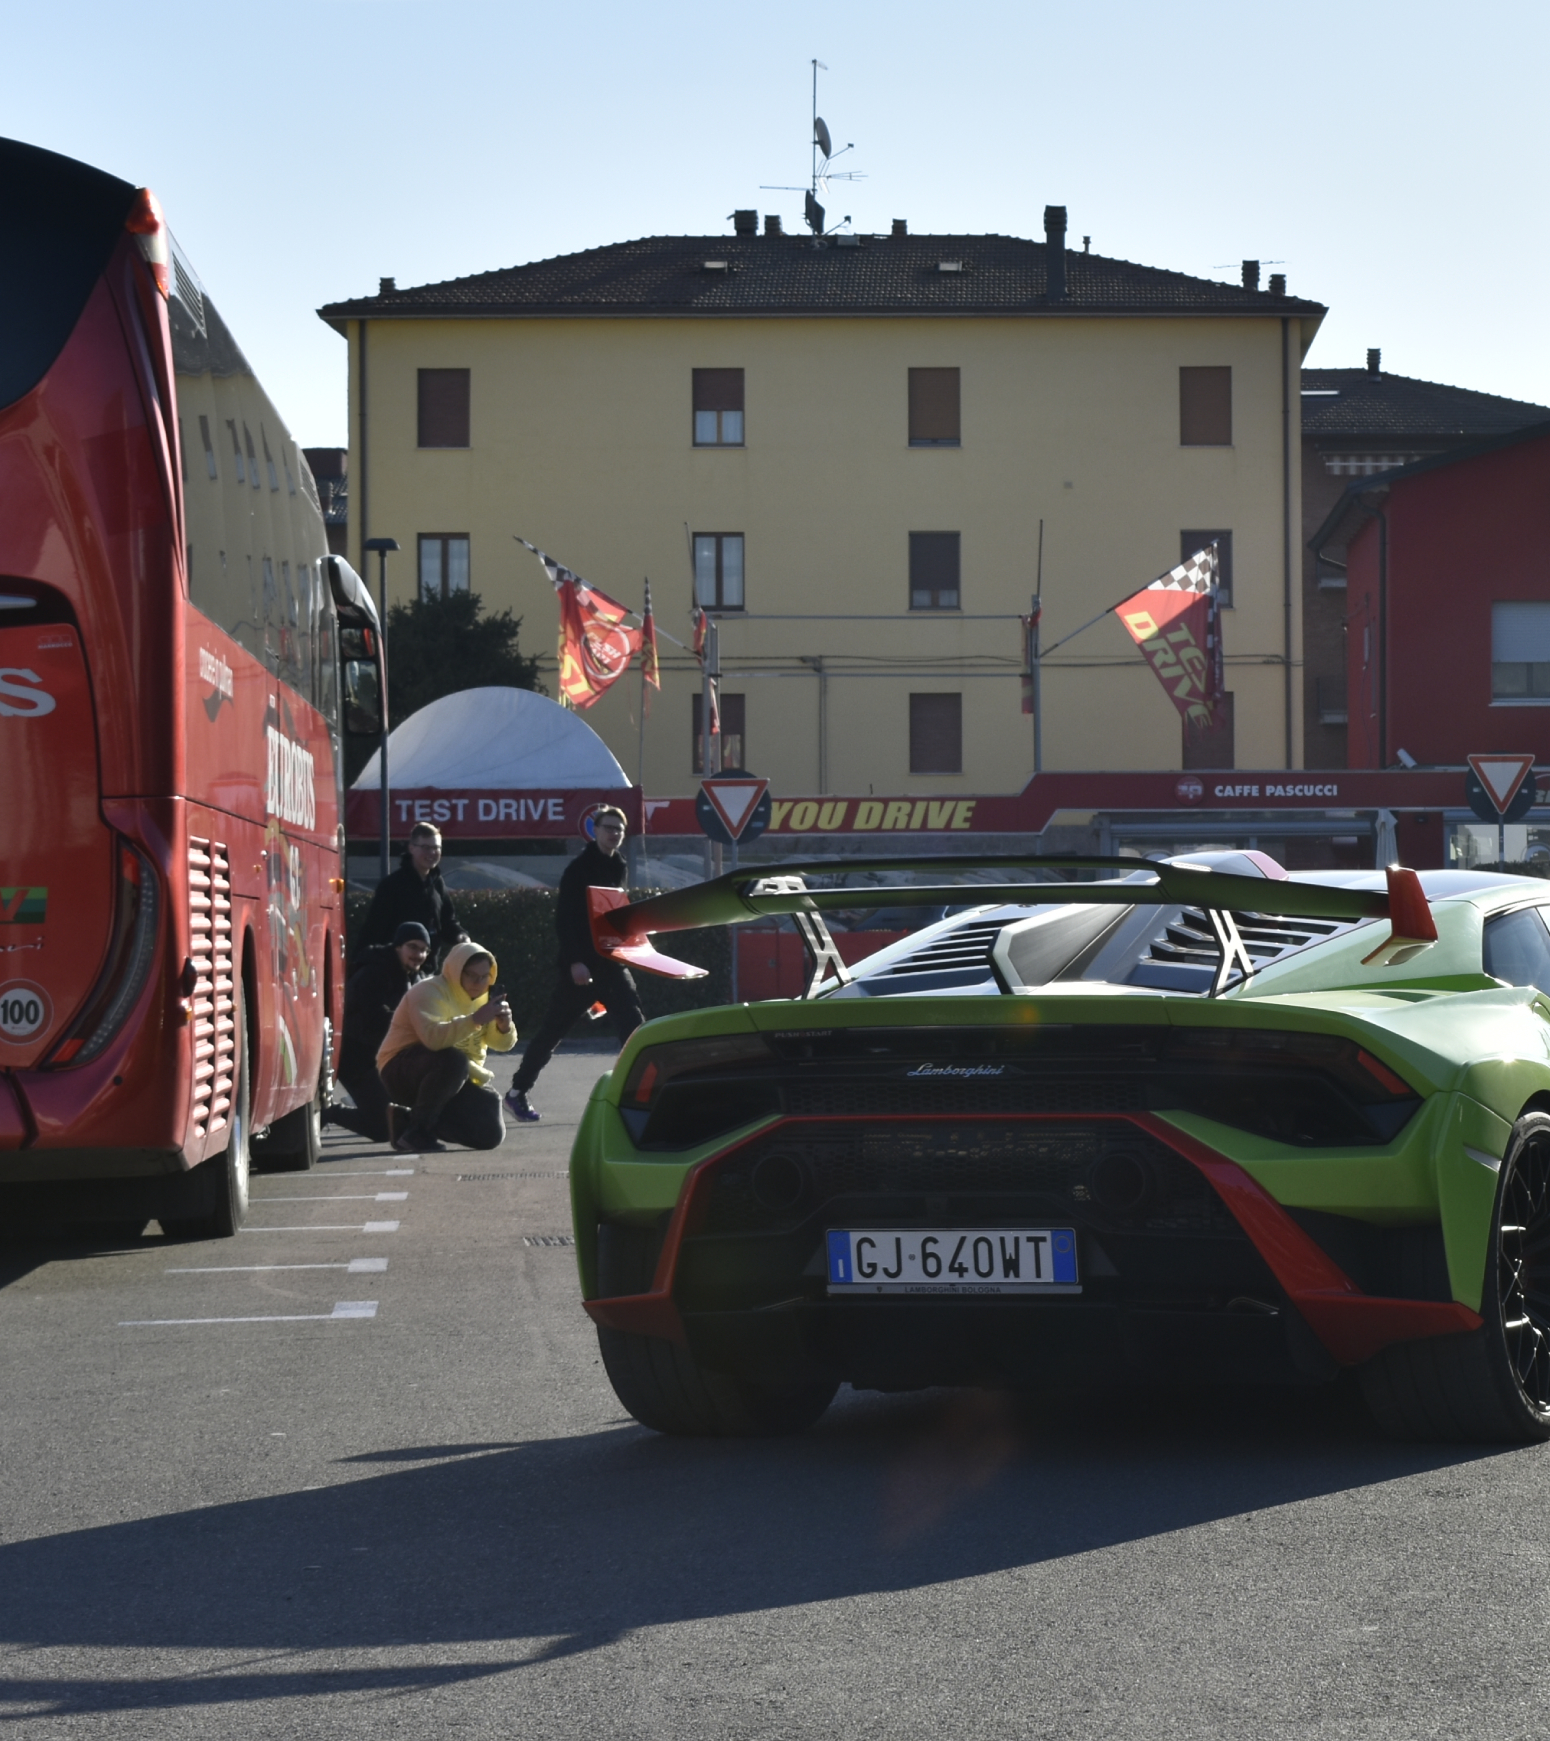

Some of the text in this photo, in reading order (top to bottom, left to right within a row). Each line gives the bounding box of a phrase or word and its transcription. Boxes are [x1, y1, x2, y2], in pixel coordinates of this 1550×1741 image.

[267, 725, 316, 832] EUROBUS
[1214, 785, 1338, 797] CAFFE PASCUCCI
[395, 798, 565, 822] TEST DRIVE
[768, 800, 976, 831] YOU DRIVE
[0, 1000, 40, 1025] 100
[907, 1062, 1005, 1078] Lamborghini
